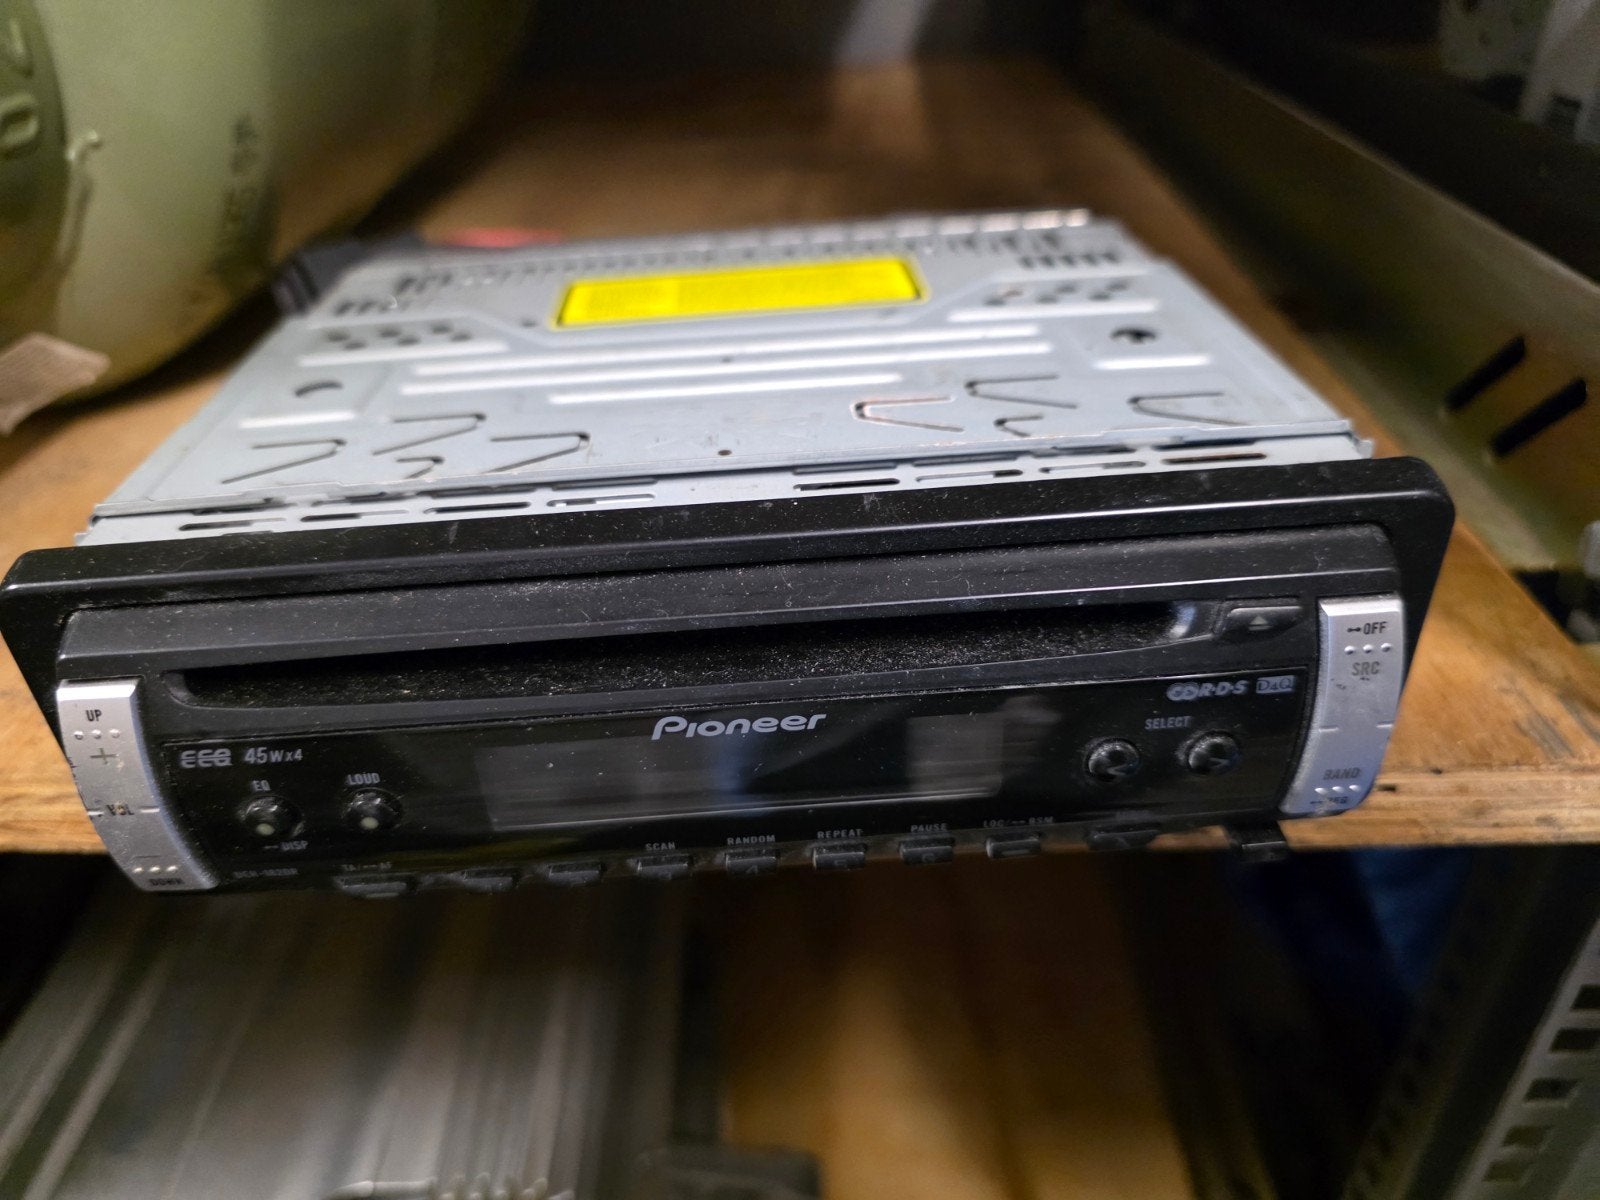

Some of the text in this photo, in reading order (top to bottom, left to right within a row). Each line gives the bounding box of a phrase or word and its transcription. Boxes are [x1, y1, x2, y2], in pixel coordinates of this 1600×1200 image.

[1362, 621, 1388, 635] OFF
[1351, 660, 1381, 676] SRC
[85, 709, 103, 722] UP
[651, 713, 827, 741] Pioneer
[1144, 715, 1192, 730] SELECT
[180, 748, 233, 769] EEQ
[347, 772, 381, 786] LOUD
[1323, 767, 1362, 780] BAND
[253, 779, 271, 792] EQ
[106, 803, 135, 817] VOL
[817, 828, 862, 839] REPEAT
[910, 822, 948, 833] PAUSE
[645, 841, 676, 851] SCAN
[726, 834, 776, 846] RANDOM
